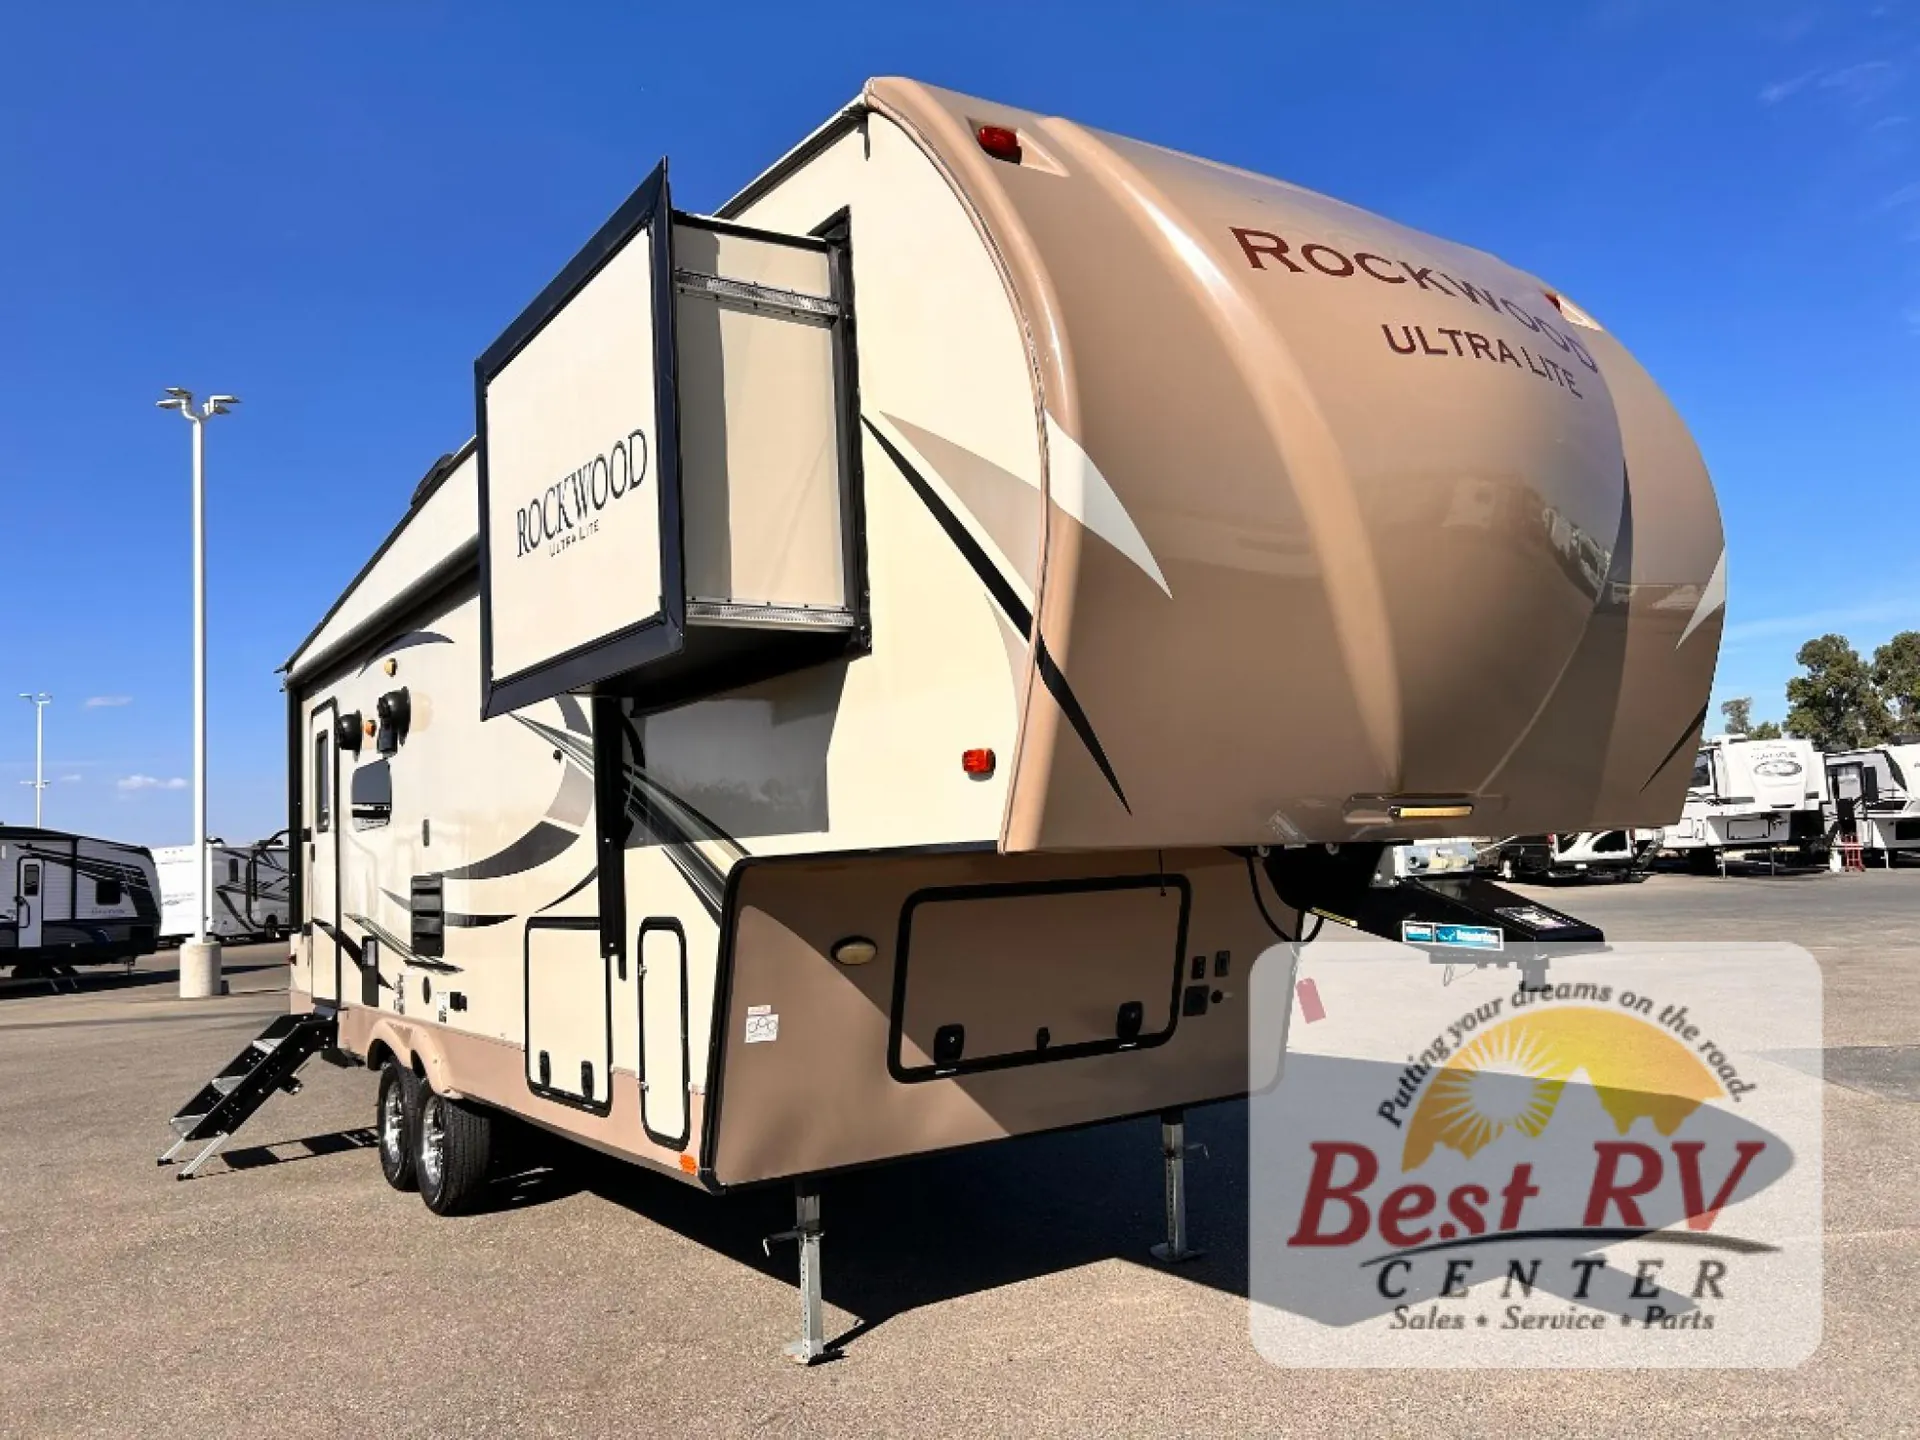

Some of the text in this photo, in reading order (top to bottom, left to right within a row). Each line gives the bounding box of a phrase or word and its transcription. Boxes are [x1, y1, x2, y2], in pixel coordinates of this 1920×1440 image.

[1230, 226, 1598, 374] ROCKWOOD
[1382, 323, 1583, 400] ULTRA LITE
[517, 428, 648, 558] ROCKWOOD
